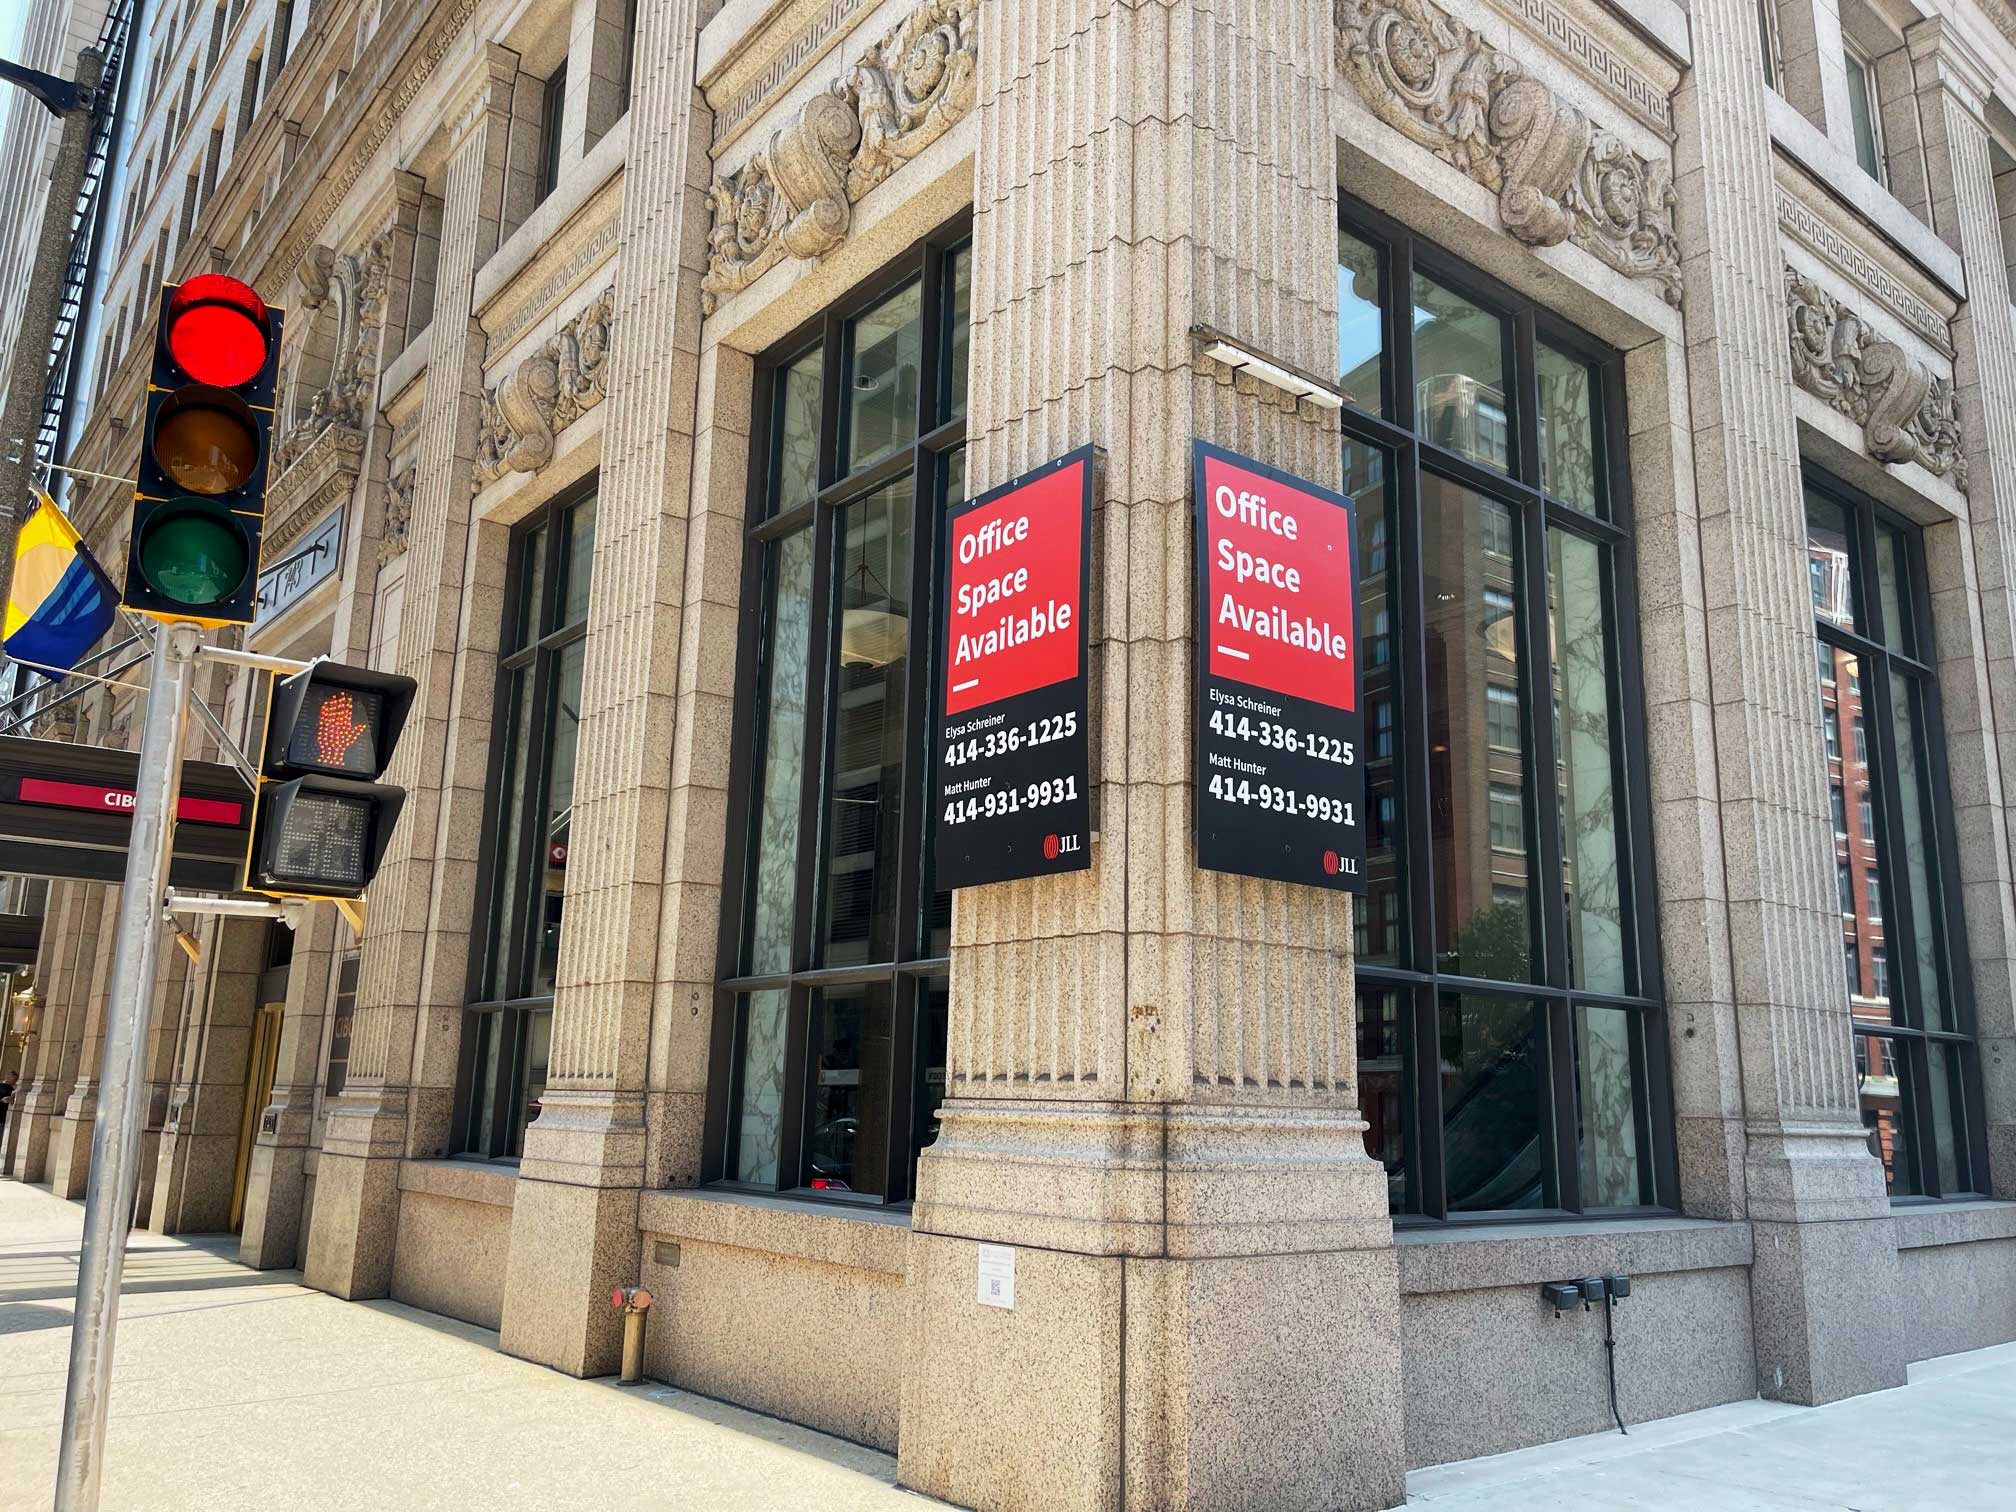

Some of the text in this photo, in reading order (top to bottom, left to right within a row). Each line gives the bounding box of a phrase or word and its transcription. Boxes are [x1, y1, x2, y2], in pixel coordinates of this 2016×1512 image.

[1215, 485, 1298, 541] Office
[959, 516, 1029, 564] Office
[1217, 538, 1300, 593] Space
[957, 567, 1028, 617] Space
[954, 599, 1072, 665] Available
[1218, 593, 1346, 660] Available
[945, 713, 1006, 740] Elysa Schreiner
[1209, 688, 1282, 717] Elysa Schreiner
[944, 711, 1078, 767] 414-336-1225
[1209, 709, 1354, 766] 414-336-1225
[944, 776, 992, 797] Matt Hunter
[1209, 752, 1267, 776] Matt Hunter
[943, 775, 1078, 825] 414-931-9931
[1208, 774, 1355, 826] 414-931-9931
[1059, 834, 1081, 853] JLL
[1338, 856, 1359, 875] JLL
